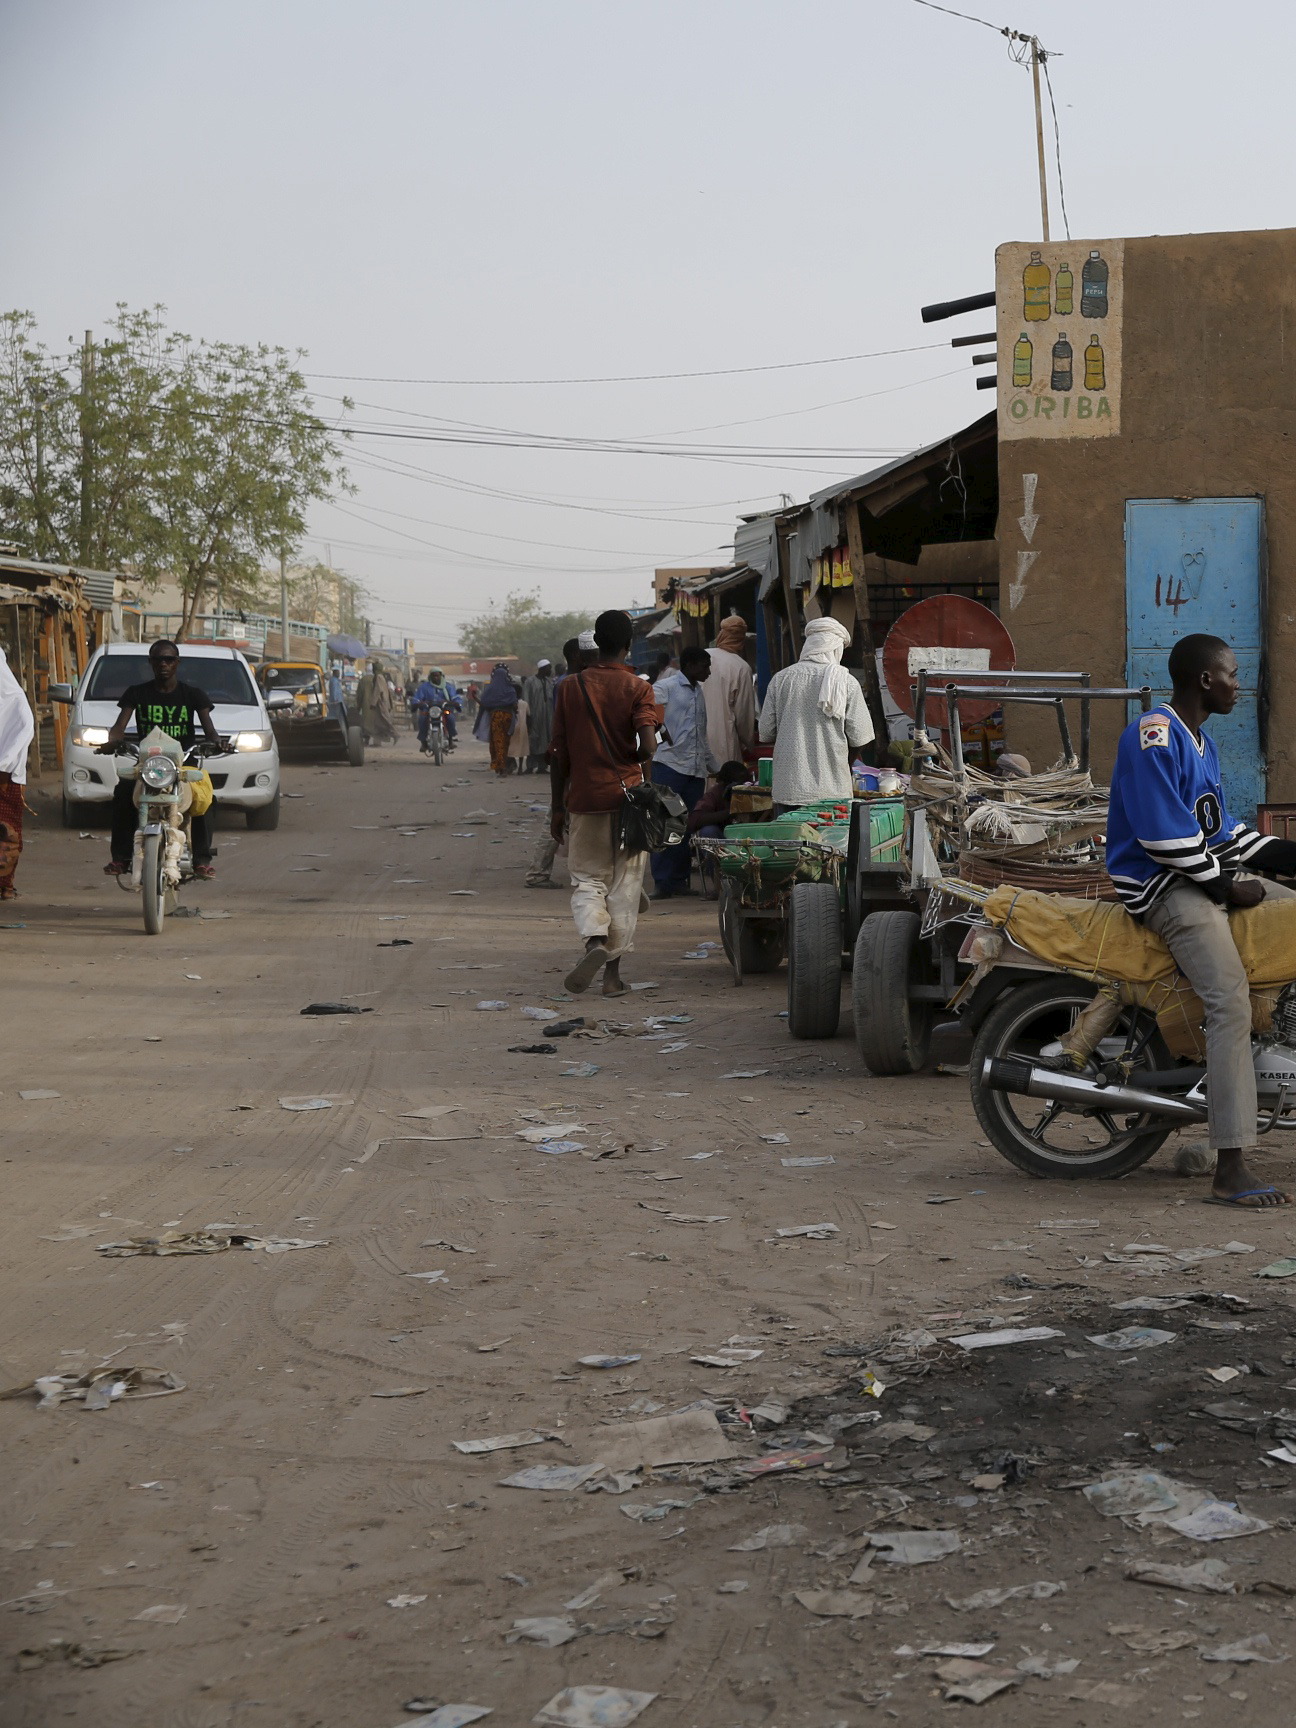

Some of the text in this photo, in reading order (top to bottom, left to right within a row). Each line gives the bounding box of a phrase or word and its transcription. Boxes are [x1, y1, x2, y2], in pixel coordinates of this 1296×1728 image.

[1010, 396, 1112, 420] ORIBA
[1154, 574, 1190, 618] 14
[138, 704, 188, 723] LIBYA
